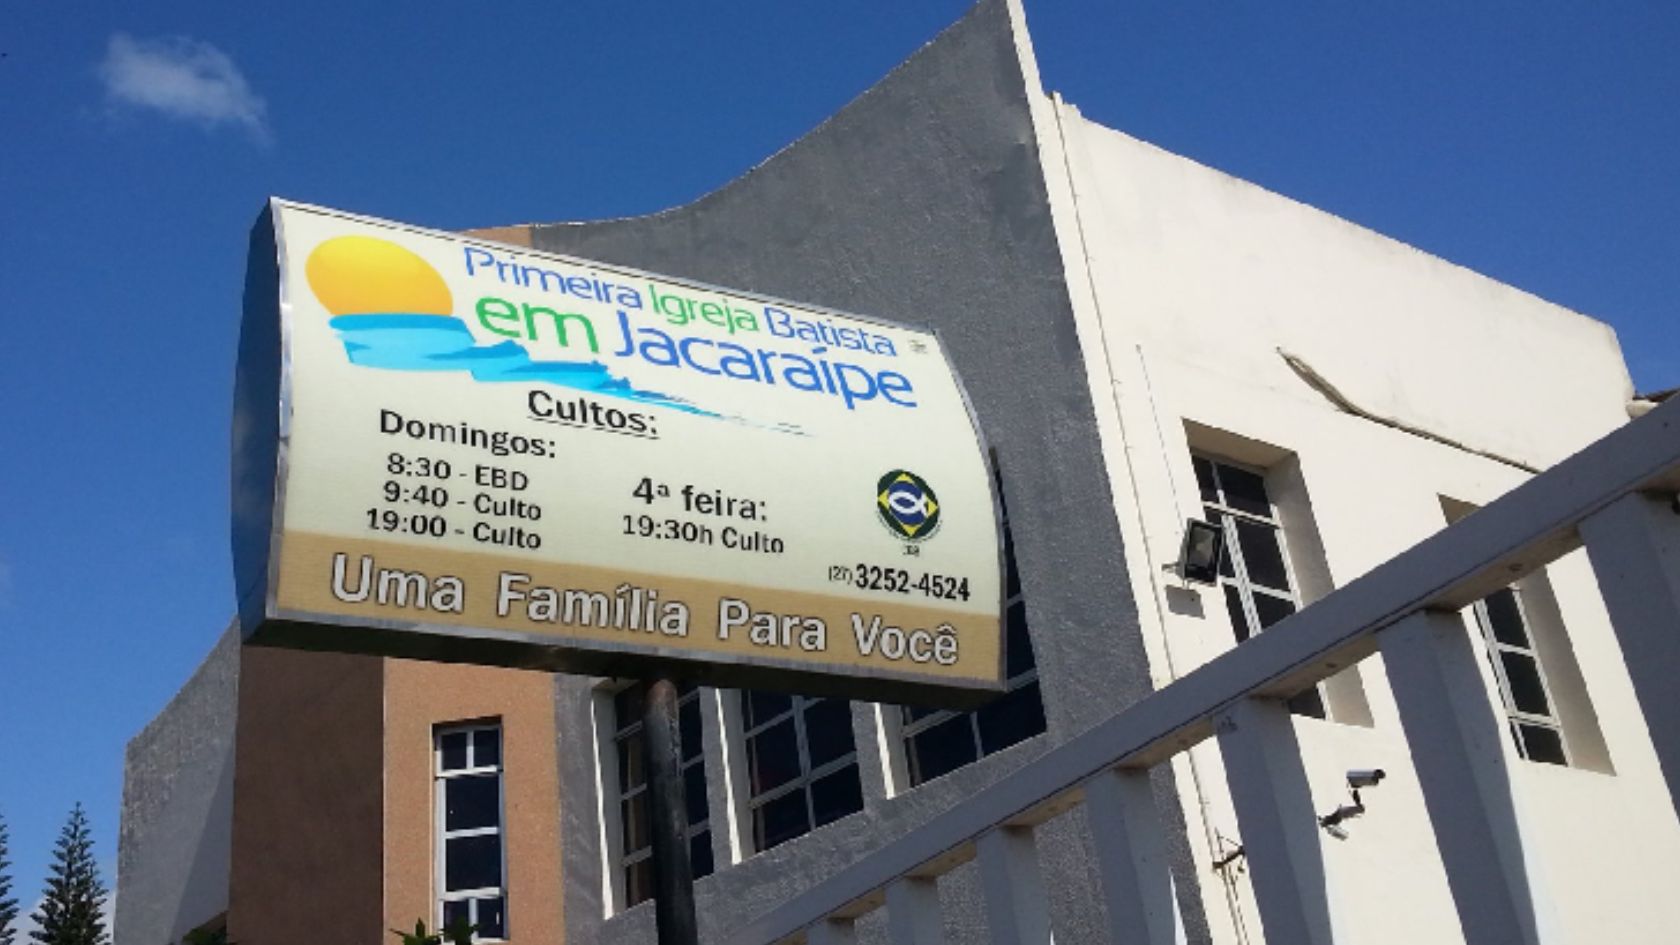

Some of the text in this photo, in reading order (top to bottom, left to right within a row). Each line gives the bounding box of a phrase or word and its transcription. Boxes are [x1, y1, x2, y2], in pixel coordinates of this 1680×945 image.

[463, 246, 897, 357] Primeira Igreja Batista
[475, 297, 918, 410] em Jacaraípe
[379, 408, 556, 459] Domingos:
[528, 389, 658, 437] Cultos:
[386, 452, 452, 480] 8:30
[474, 464, 530, 492] EBD
[383, 480, 449, 508] 9:40
[473, 493, 543, 522] Culto
[680, 484, 769, 522] feira:
[366, 507, 447, 537] 19:00
[472, 521, 543, 550] Culto
[622, 514, 785, 554] 19:30h Culto
[855, 562, 972, 602] 3252-4524
[330, 551, 959, 666] Uma Família Para Você
